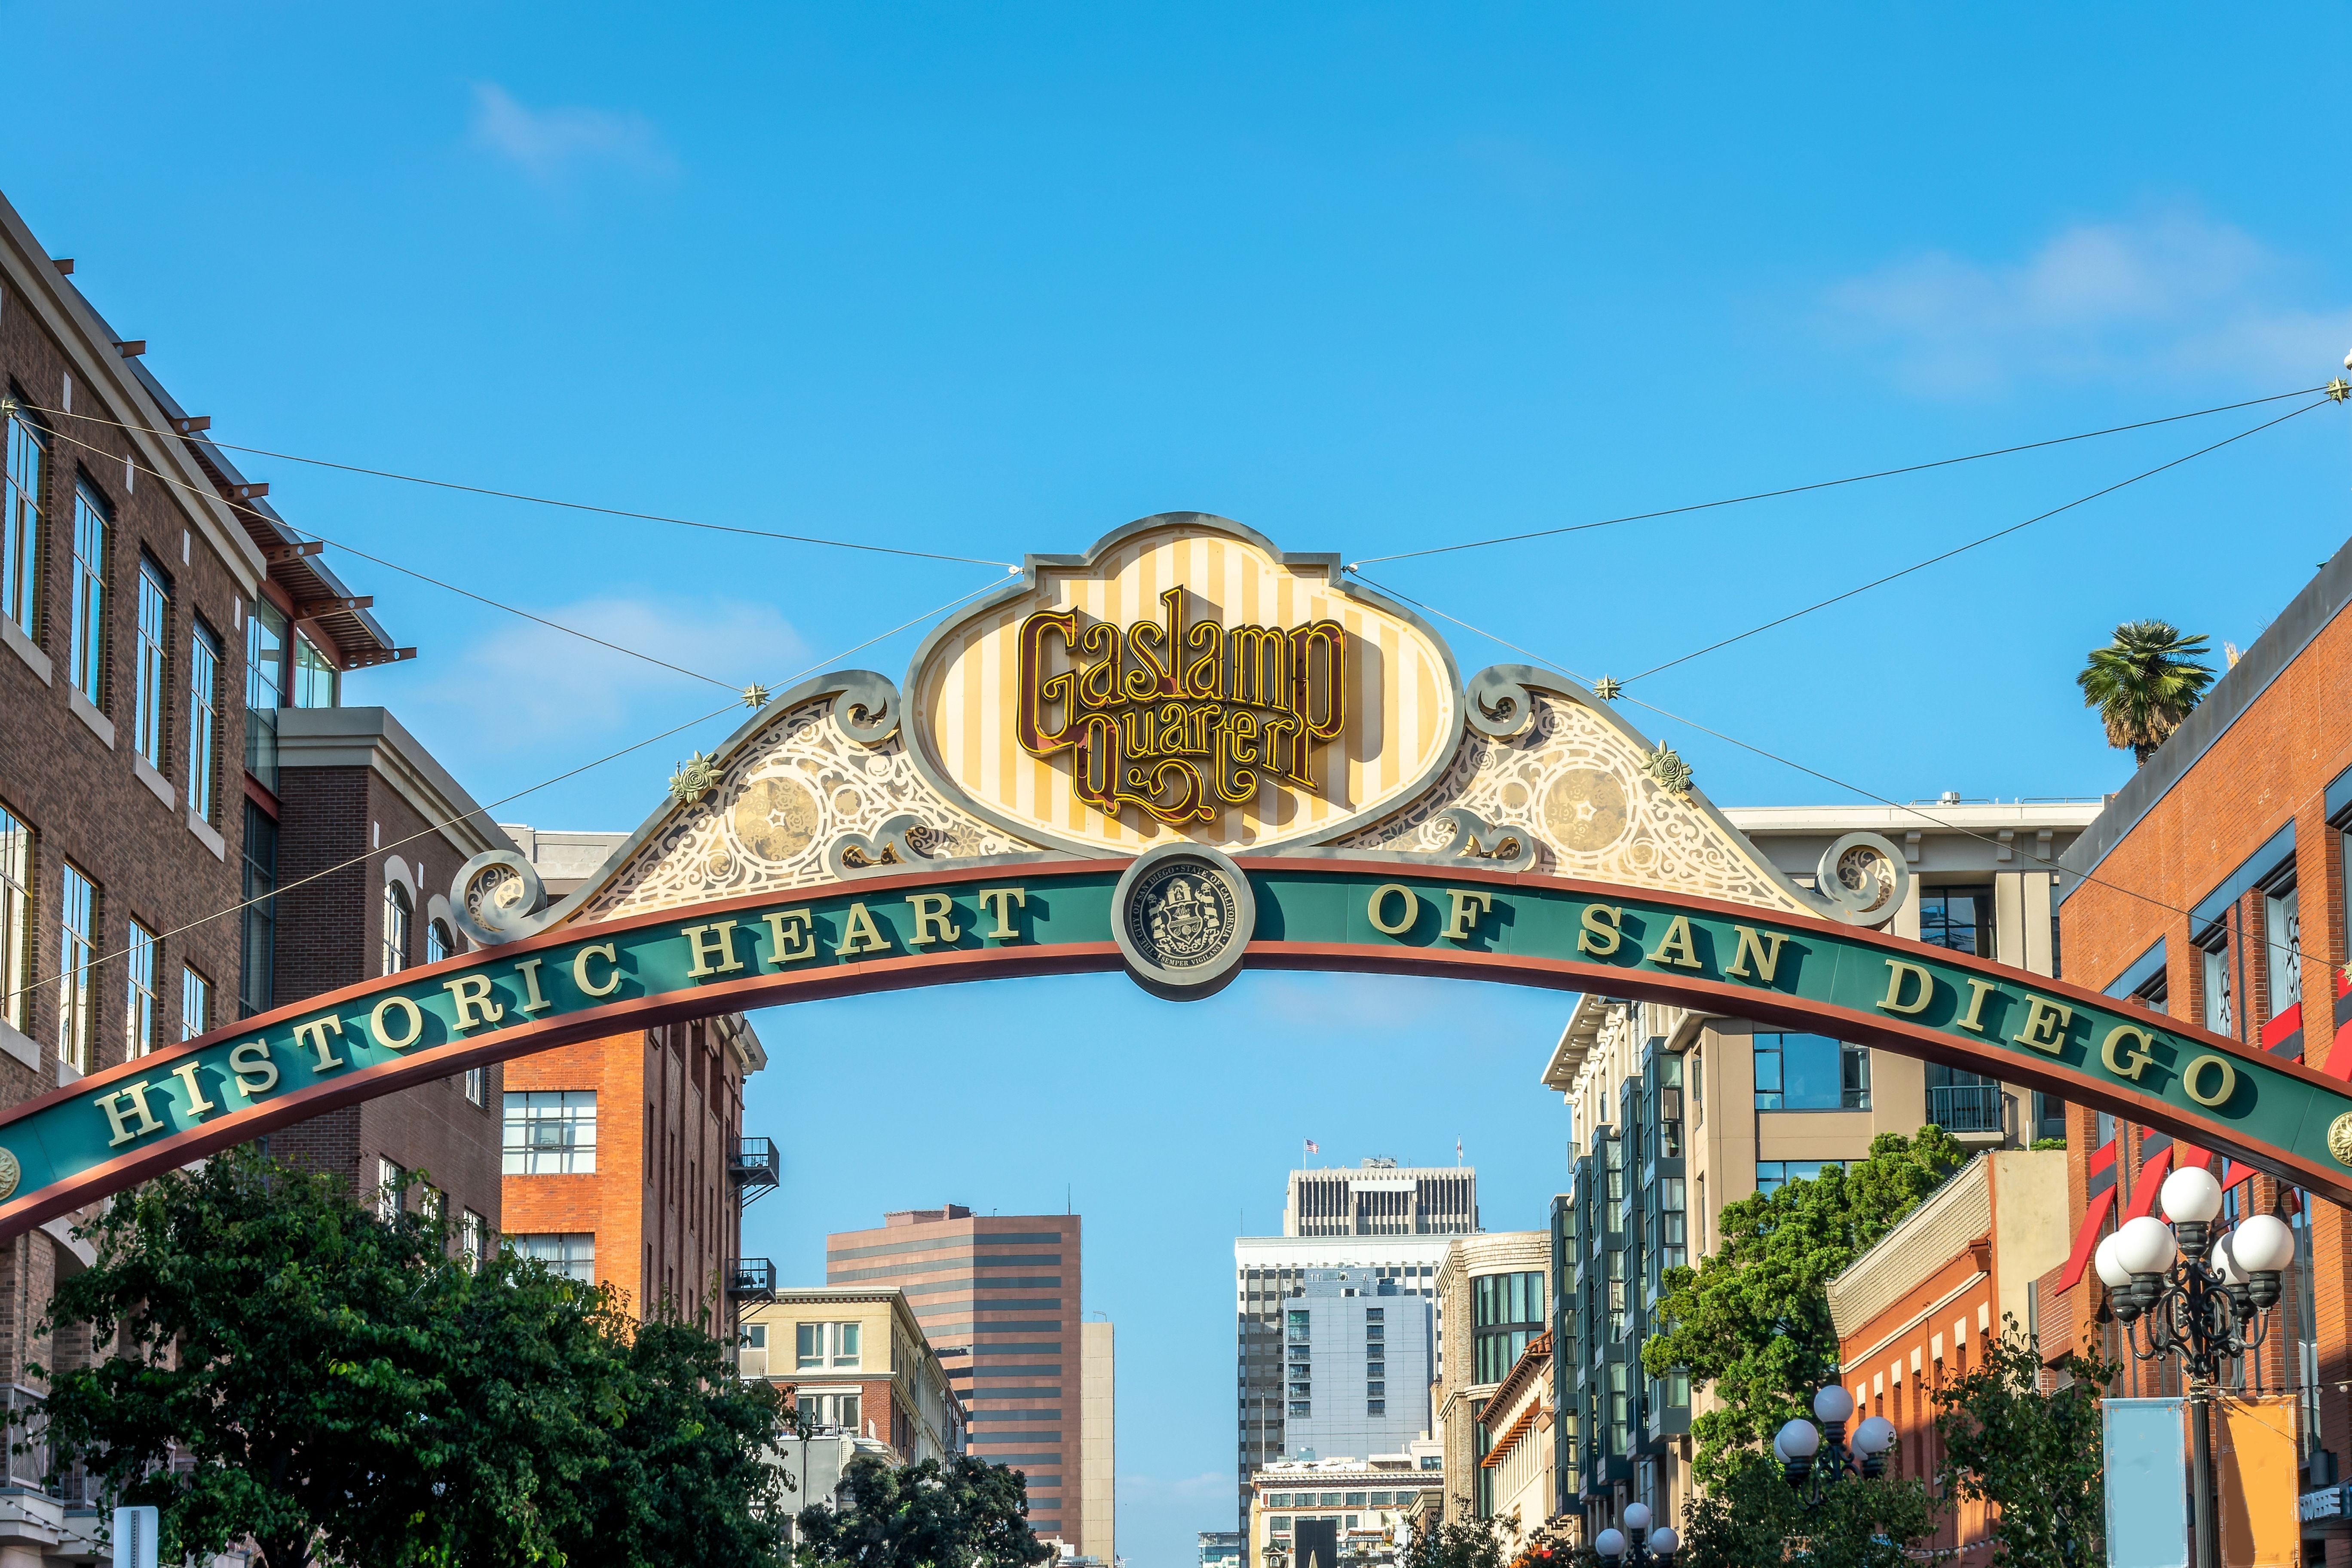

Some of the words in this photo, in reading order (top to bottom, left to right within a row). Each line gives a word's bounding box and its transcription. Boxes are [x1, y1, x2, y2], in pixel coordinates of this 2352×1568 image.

[1016, 584, 1347, 793] Gaslamp
[1072, 701, 1302, 826] Quarter
[1148, 867, 1174, 884] DIEGO
[1181, 865, 1209, 878] STATE
[1210, 875, 1222, 887] OF
[1136, 884, 1149, 900] SAN
[1133, 902, 1141, 914] OF
[1220, 886, 1235, 937] CALIFORNIA
[1133, 918, 1141, 937] CITY
[1139, 937, 1153, 956] THE
[1161, 956, 1188, 966] SEMPER
[1191, 945, 1221, 965] VIGILANS
[94, 943, 620, 1147] HISTORIC
[681, 887, 1025, 978] HEART
[1367, 883, 1491, 940] OF
[1577, 903, 1789, 982] SAN
[1876, 959, 2236, 1106] DIEGO
